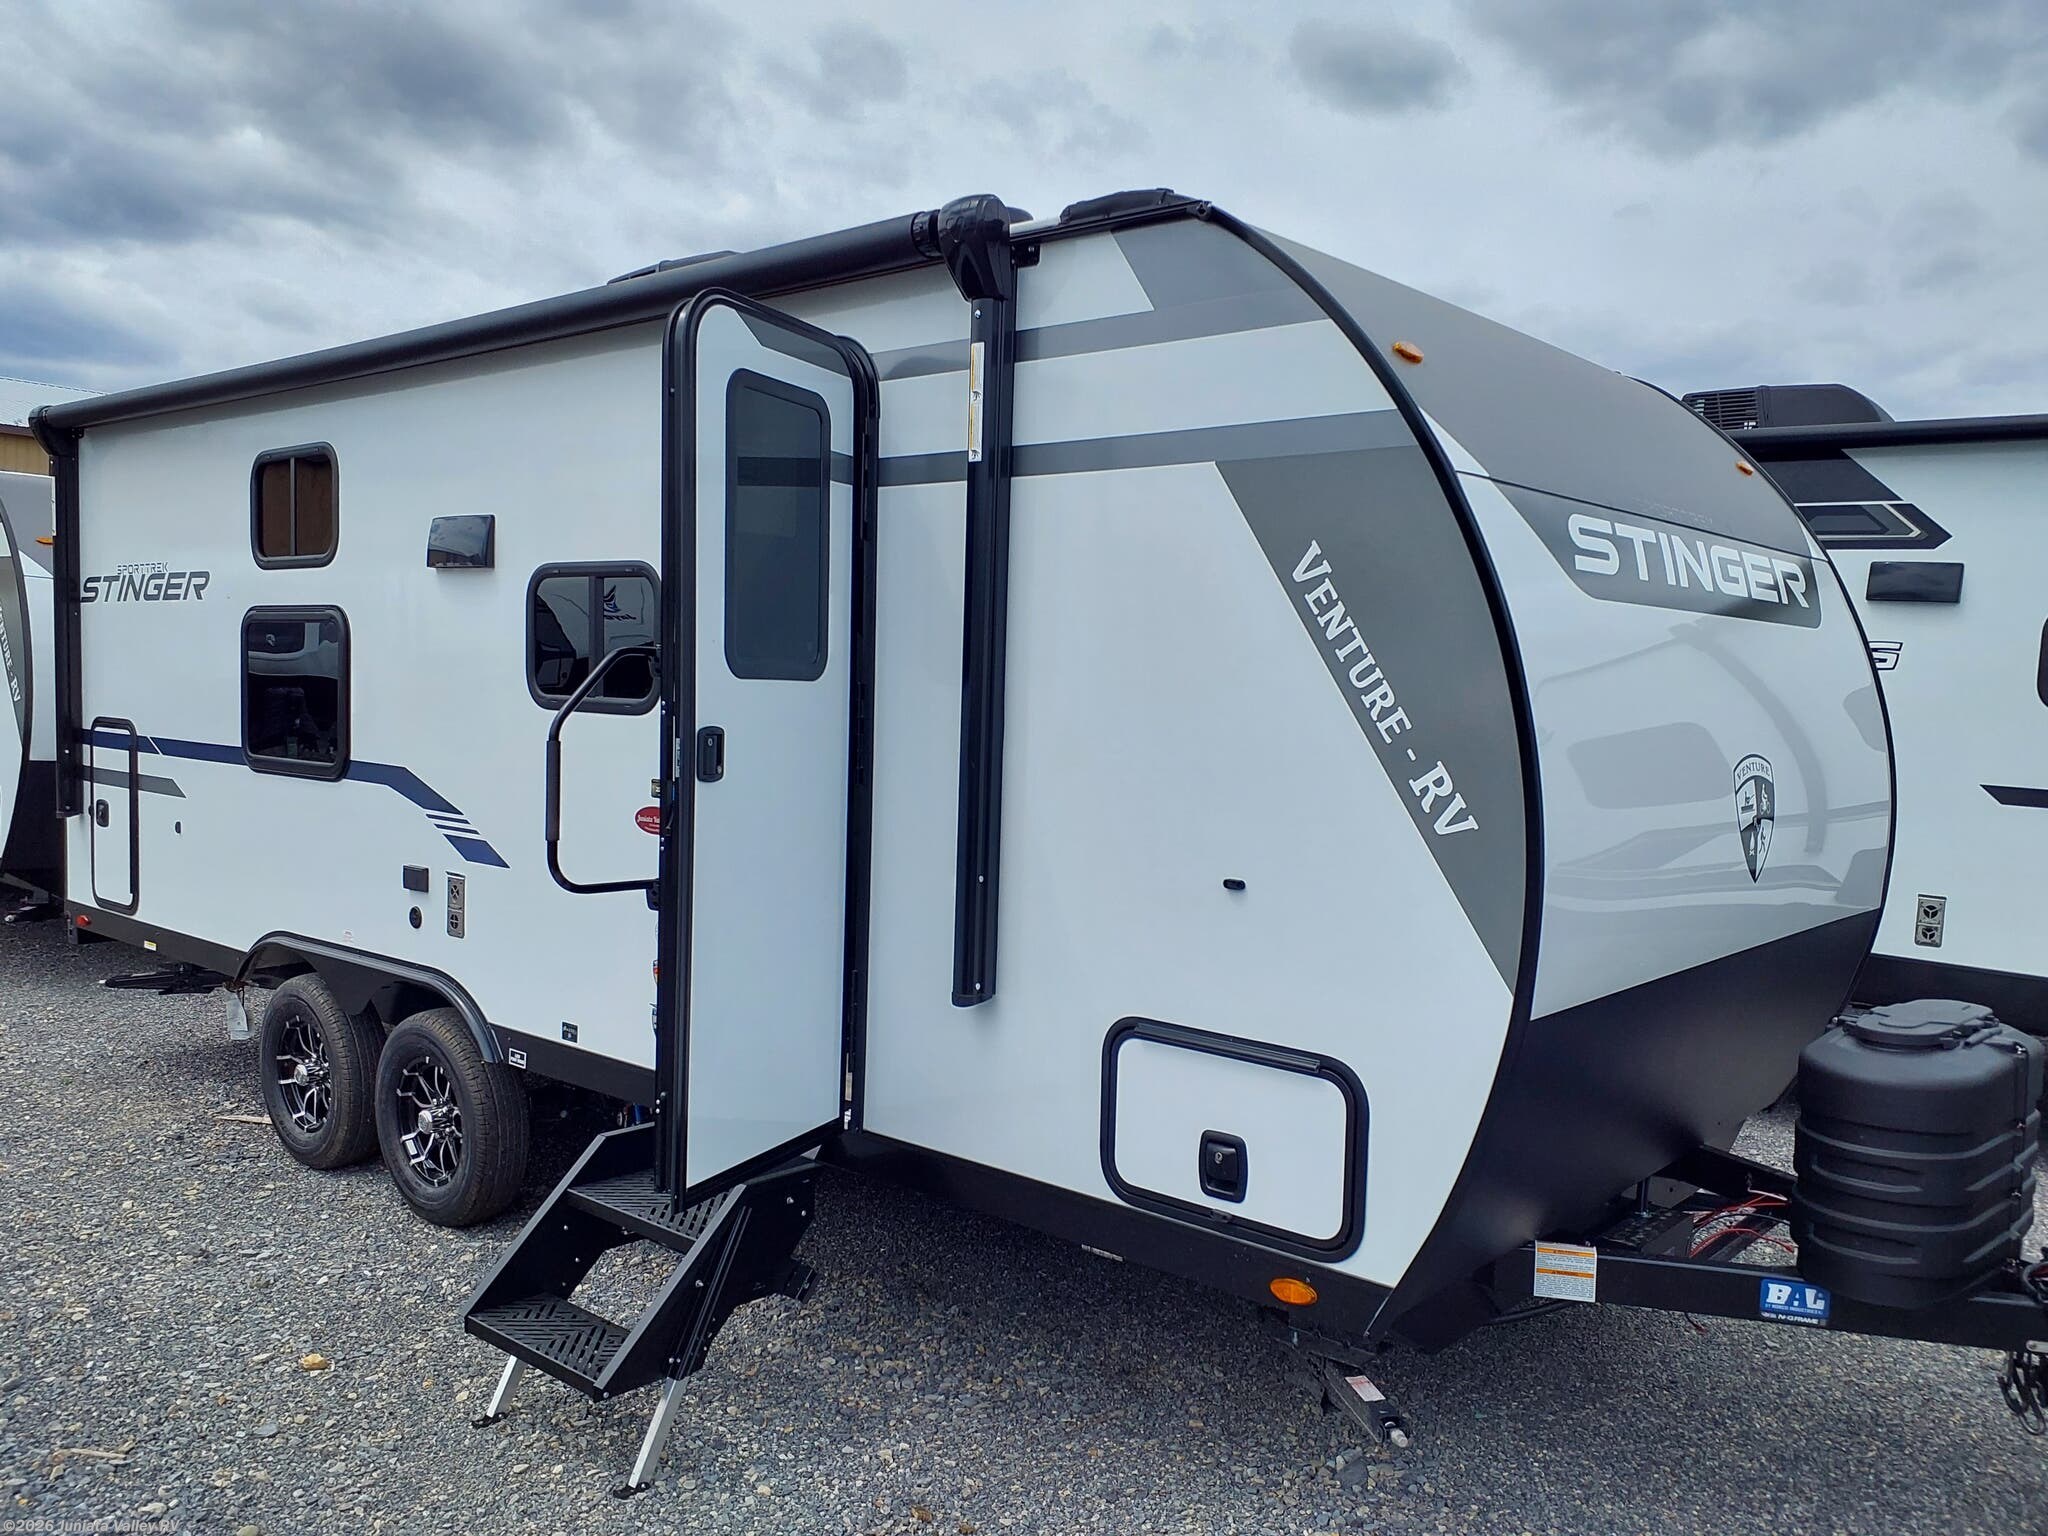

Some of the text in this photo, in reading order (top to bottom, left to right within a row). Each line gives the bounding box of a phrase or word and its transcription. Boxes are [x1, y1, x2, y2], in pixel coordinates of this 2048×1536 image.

[117, 561, 169, 575] SPORTTREK
[1567, 512, 1810, 609] STINGER
[80, 570, 211, 603] STINGER
[1291, 539, 1413, 744] VENTURE
[1408, 760, 1480, 836] RV
[1736, 761, 1771, 781] VENTURE
